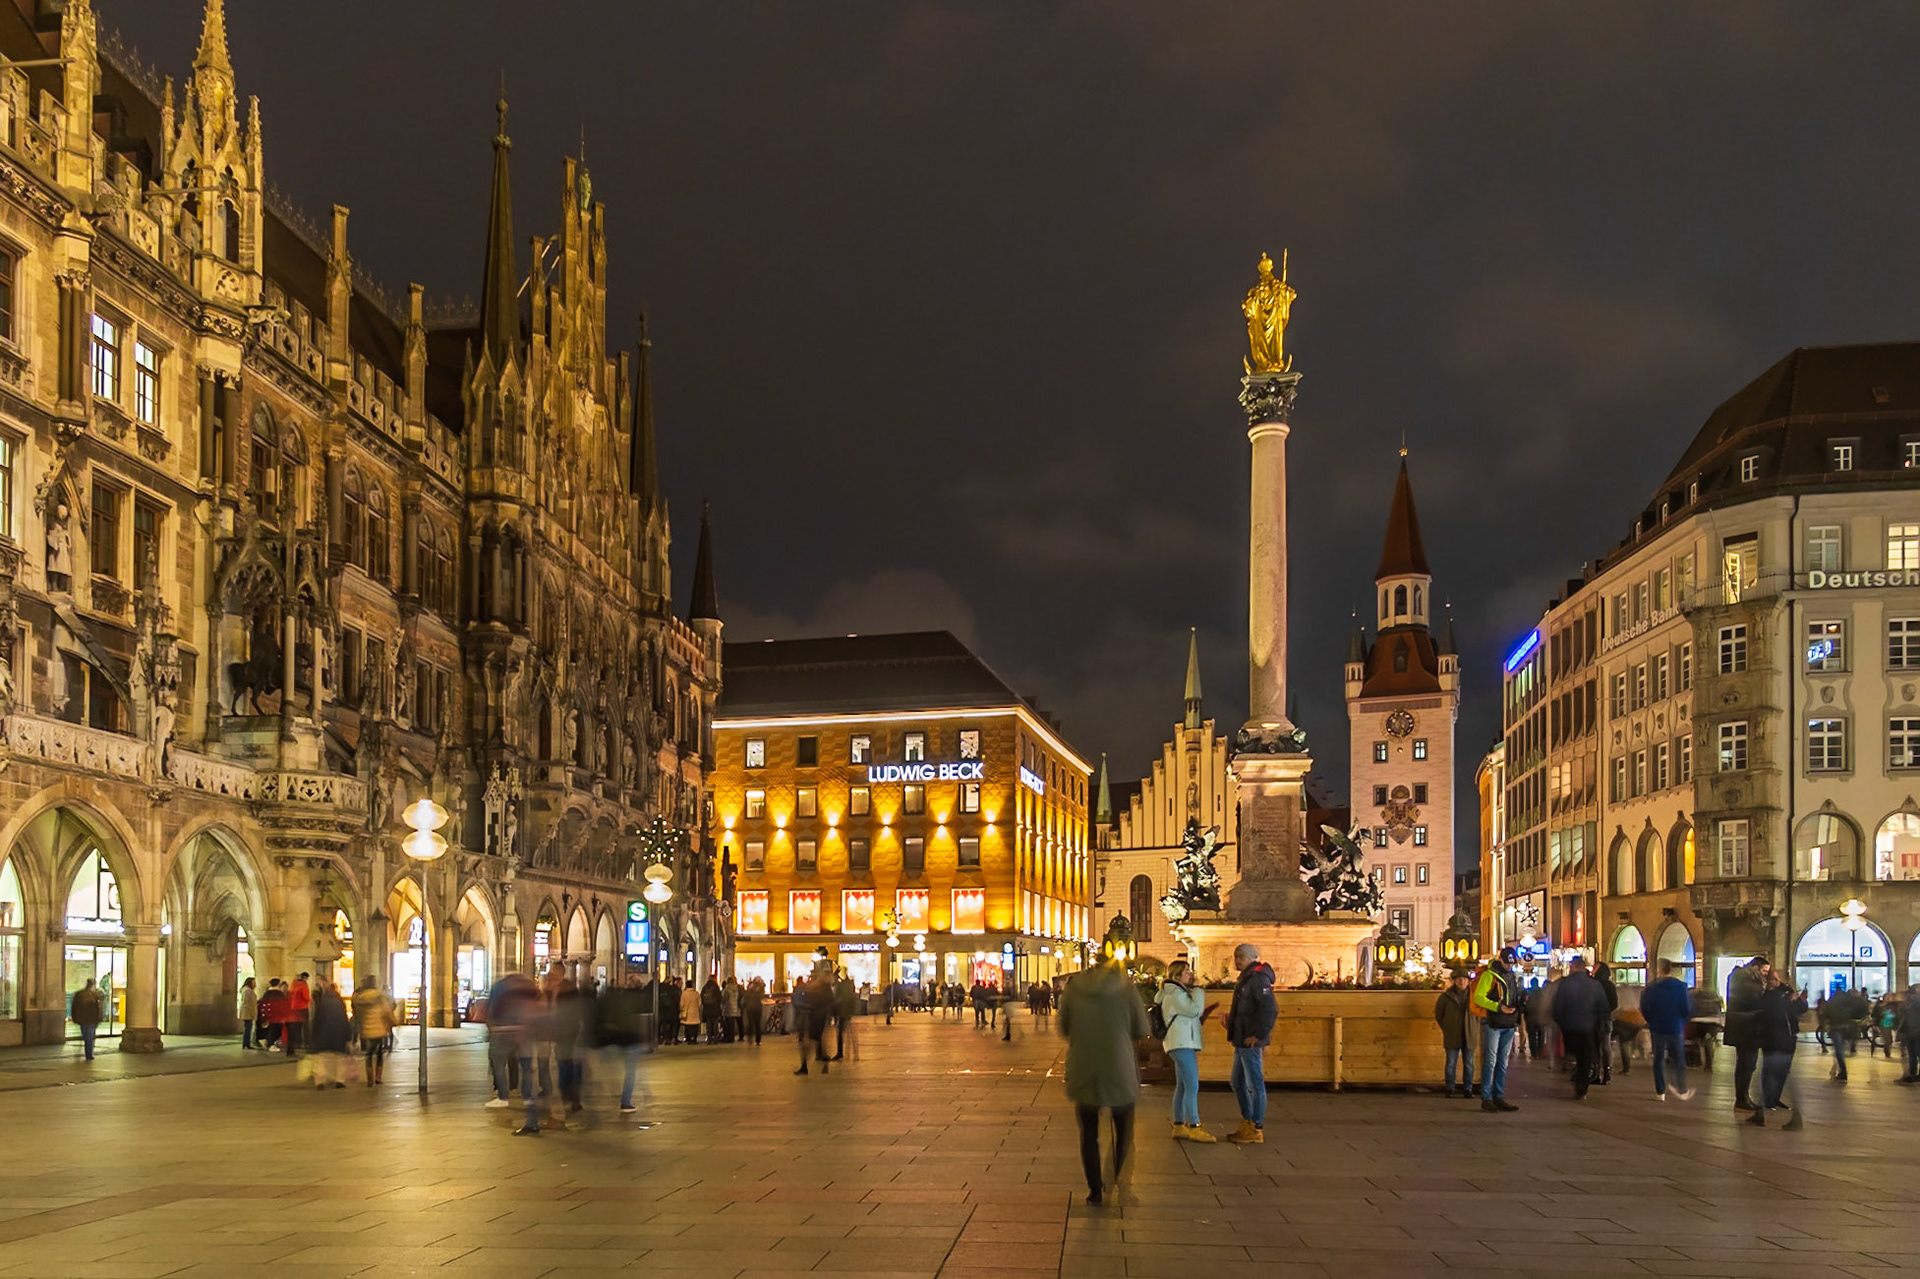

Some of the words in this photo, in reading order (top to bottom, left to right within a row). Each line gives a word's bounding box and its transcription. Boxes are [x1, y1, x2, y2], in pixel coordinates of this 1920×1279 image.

[1809, 569, 1919, 589] Deutsch
[1602, 620, 1649, 655] Deutsche
[1651, 602, 1680, 628] Bank
[868, 763, 936, 783] LUDWIG
[939, 762, 984, 781] BECK
[630, 902, 647, 921] S
[630, 924, 645, 942] U
